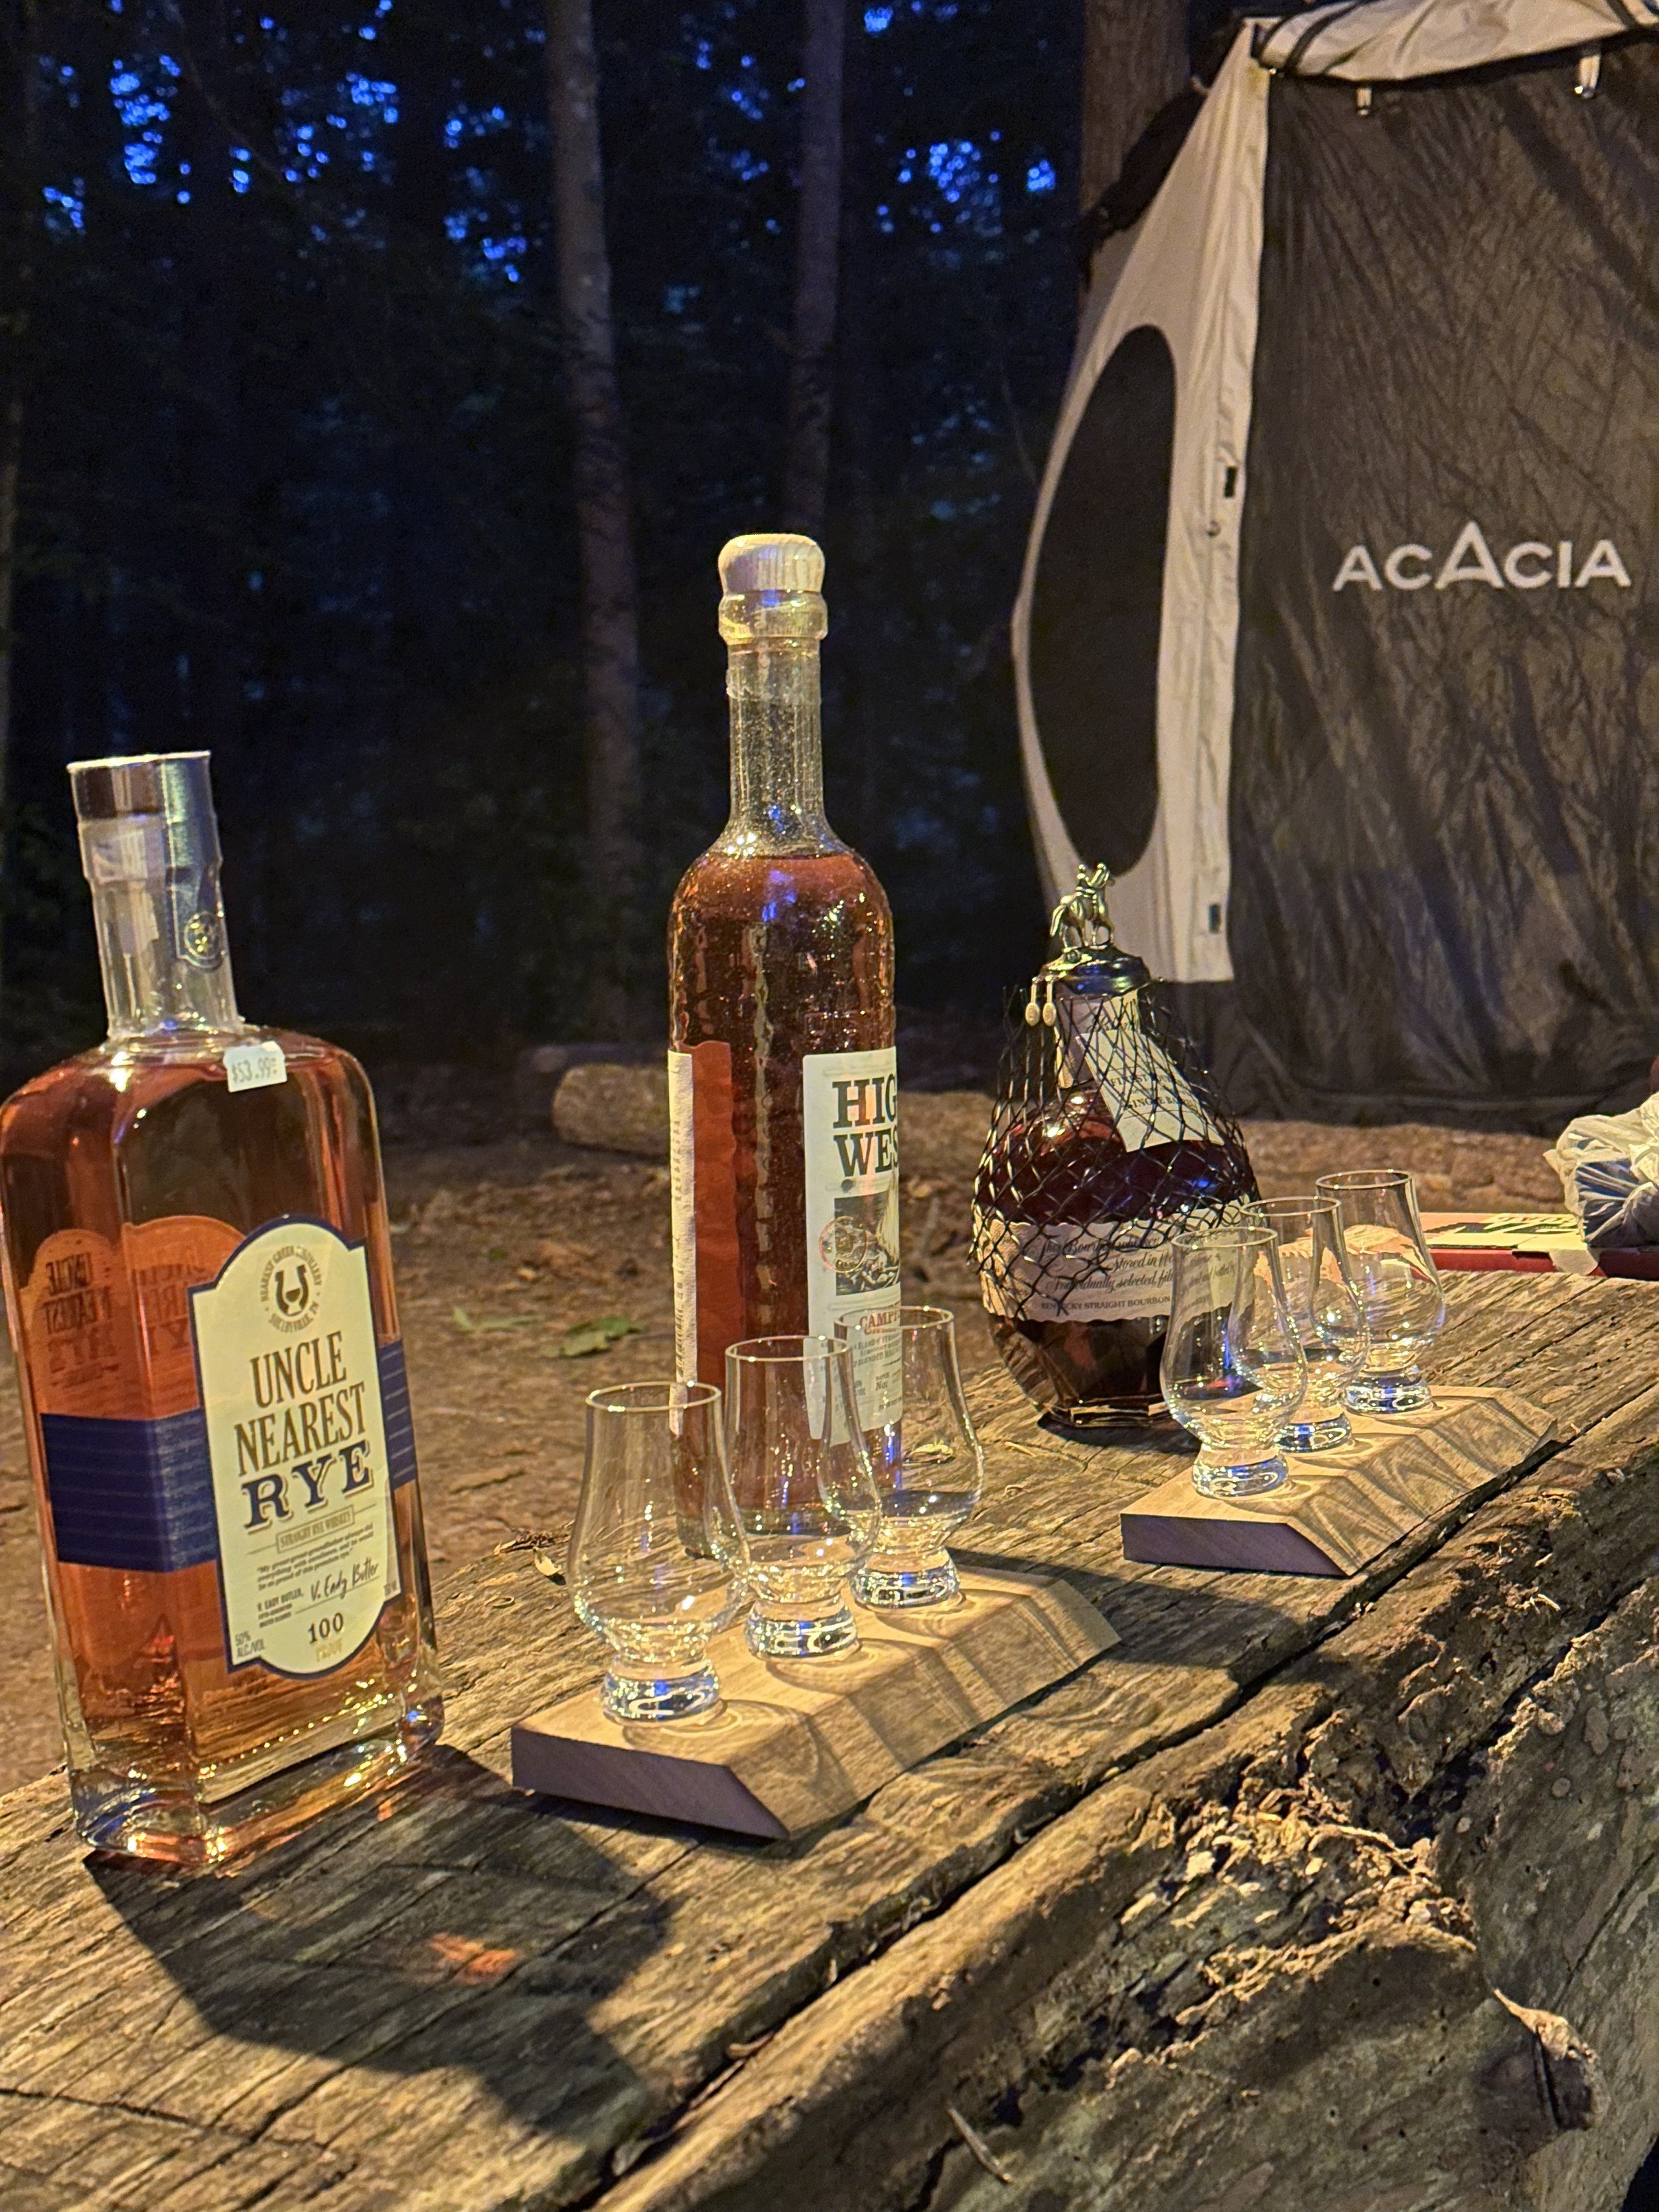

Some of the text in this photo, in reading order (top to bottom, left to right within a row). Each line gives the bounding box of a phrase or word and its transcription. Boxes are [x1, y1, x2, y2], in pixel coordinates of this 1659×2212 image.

[1333, 521, 1631, 591] ACACIA
[1108, 1252, 1148, 1272] Stored
[1147, 1254, 1157, 1267] in
[1041, 1301, 1082, 1311] KENCKY
[1084, 1300, 1125, 1310] STRAIGHT
[1128, 1296, 1171, 1307] BOURBON
[250, 1330, 347, 1408] UNCLE
[234, 1380, 366, 1477] NEAREST
[242, 1439, 374, 1534] RYE
[352, 1557, 379, 1586] Butler
[308, 1613, 344, 1644] 100
